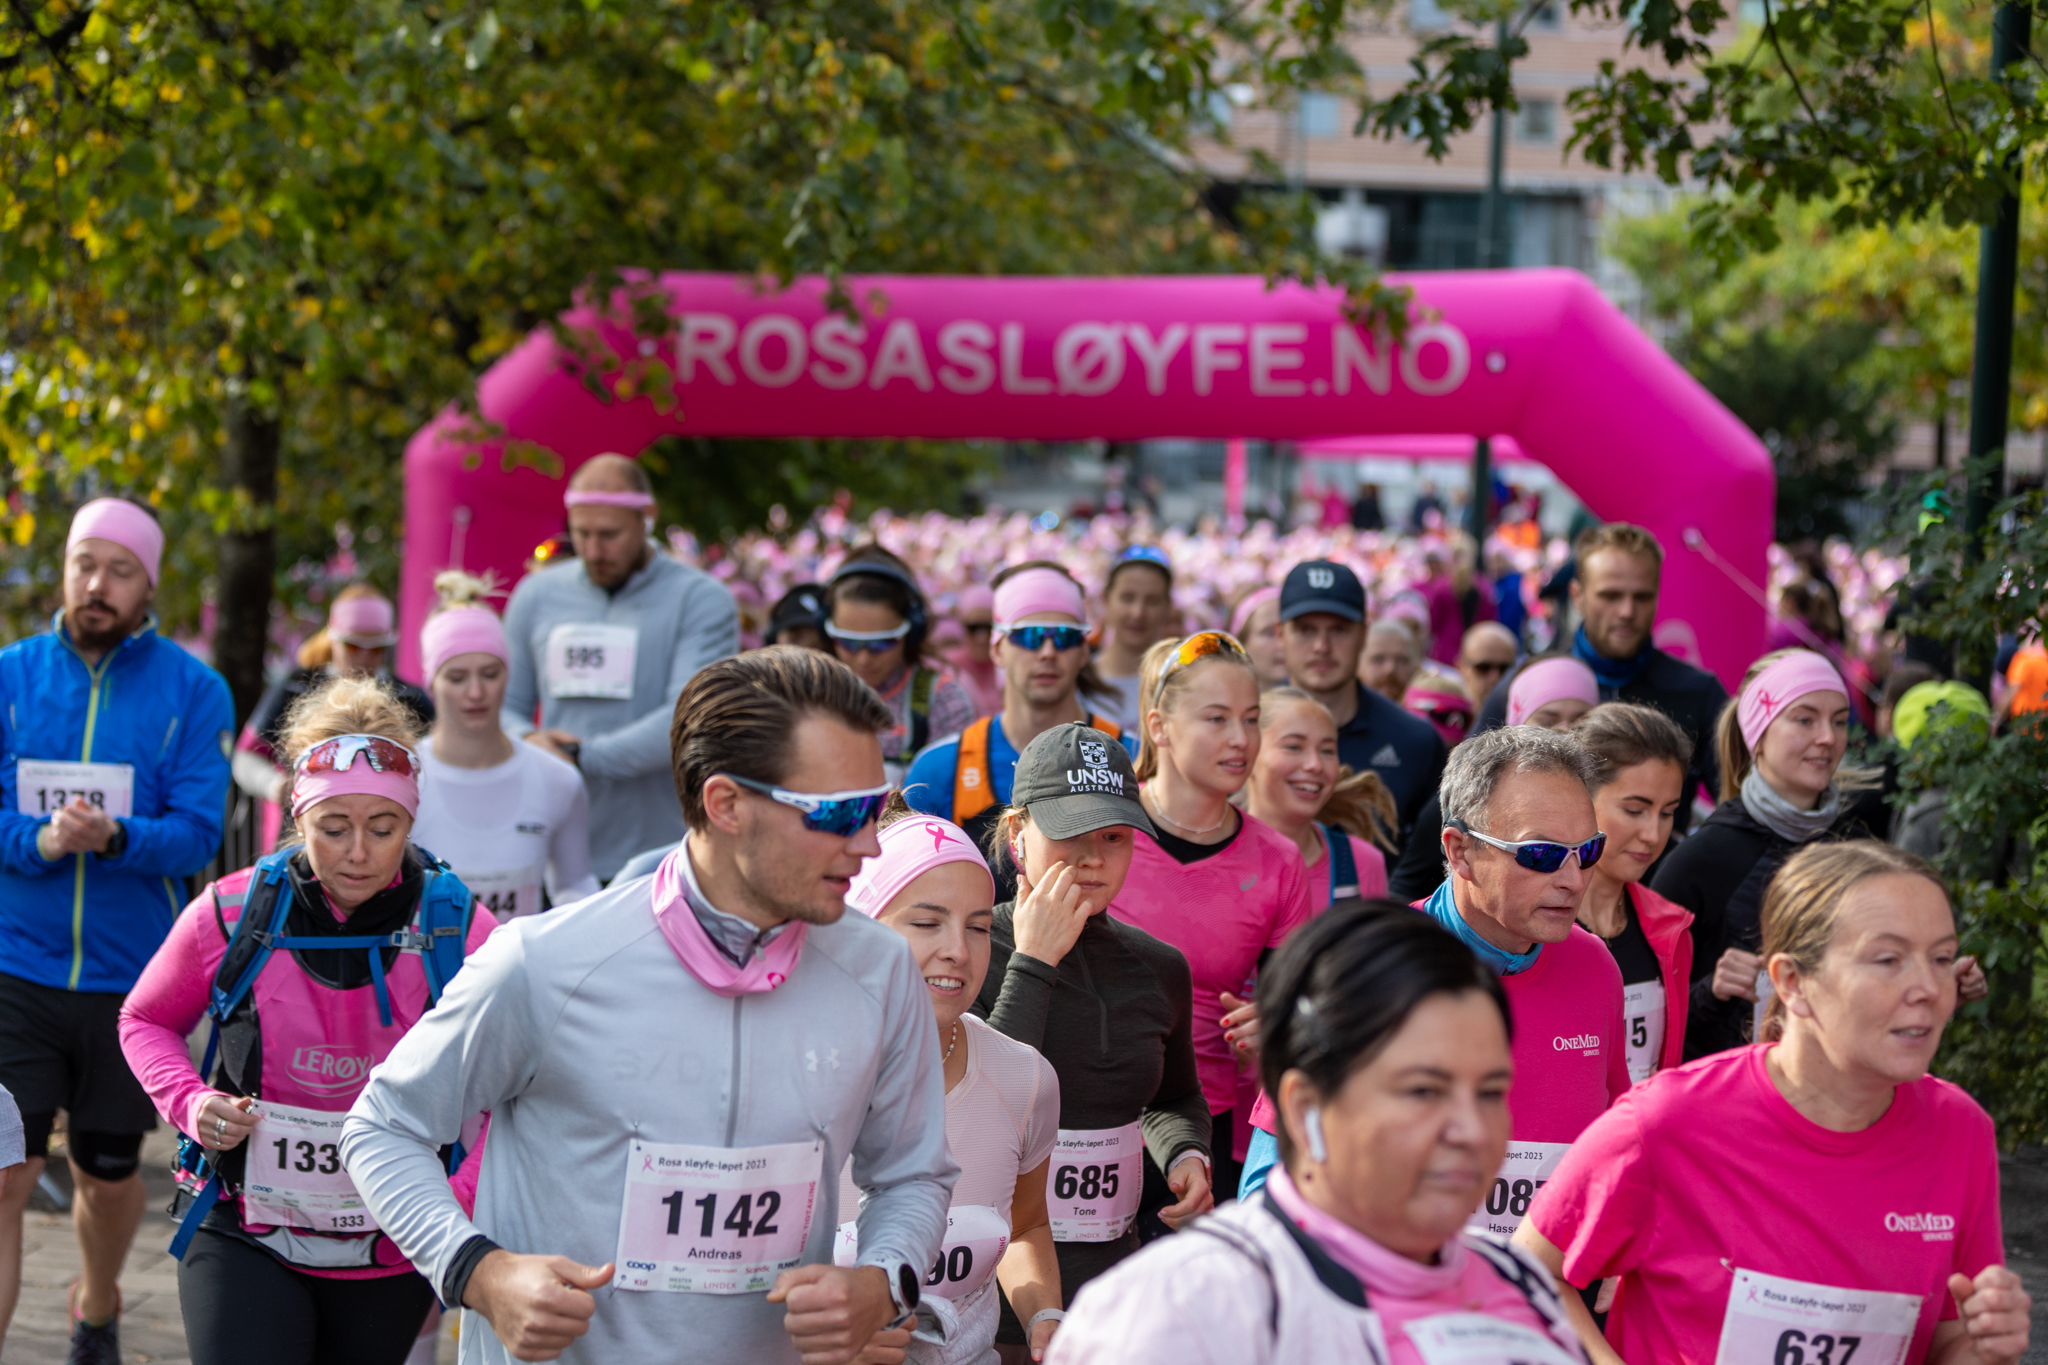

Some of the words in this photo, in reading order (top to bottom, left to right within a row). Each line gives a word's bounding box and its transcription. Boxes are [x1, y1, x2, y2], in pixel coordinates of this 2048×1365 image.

[677, 314, 1471, 397] ROSASLØYFE.NO
[565, 646, 604, 669] 595
[1067, 769, 1124, 788] UNSW
[37, 788, 105, 812] 138
[1070, 784, 1124, 796] AUSTRALIA
[474, 890, 517, 914] 44
[1624, 1016, 1647, 1048] 5
[292, 1048, 369, 1078] LERØY
[269, 1111, 286, 1120] Rosa
[1062, 1140, 1104, 1149] sløyfe-løpet
[1105, 1137, 1120, 1147] 2023
[273, 1138, 349, 1175] 133
[658, 1156, 682, 1167] Rosa
[684, 1157, 744, 1172] sløyfe-løpet
[746, 1158, 767, 1170] 2023
[1524, 1151, 1543, 1160] 2023
[1054, 1163, 1120, 1200] 685
[1473, 1177, 1548, 1217] 08
[331, 1215, 365, 1228] 1333
[662, 1190, 782, 1239] 1142
[1073, 1206, 1097, 1216] Tone
[688, 1247, 743, 1260] Andreas
[626, 1260, 657, 1272] coop
[634, 1279, 648, 1287] Kid
[703, 1281, 737, 1290] LINDEX
[1763, 1289, 1786, 1302] Rosa
[1790, 1293, 1845, 1312] sløyfe-løpet
[1846, 1303, 1867, 1314] 2023
[1774, 1329, 1862, 1365] 637
